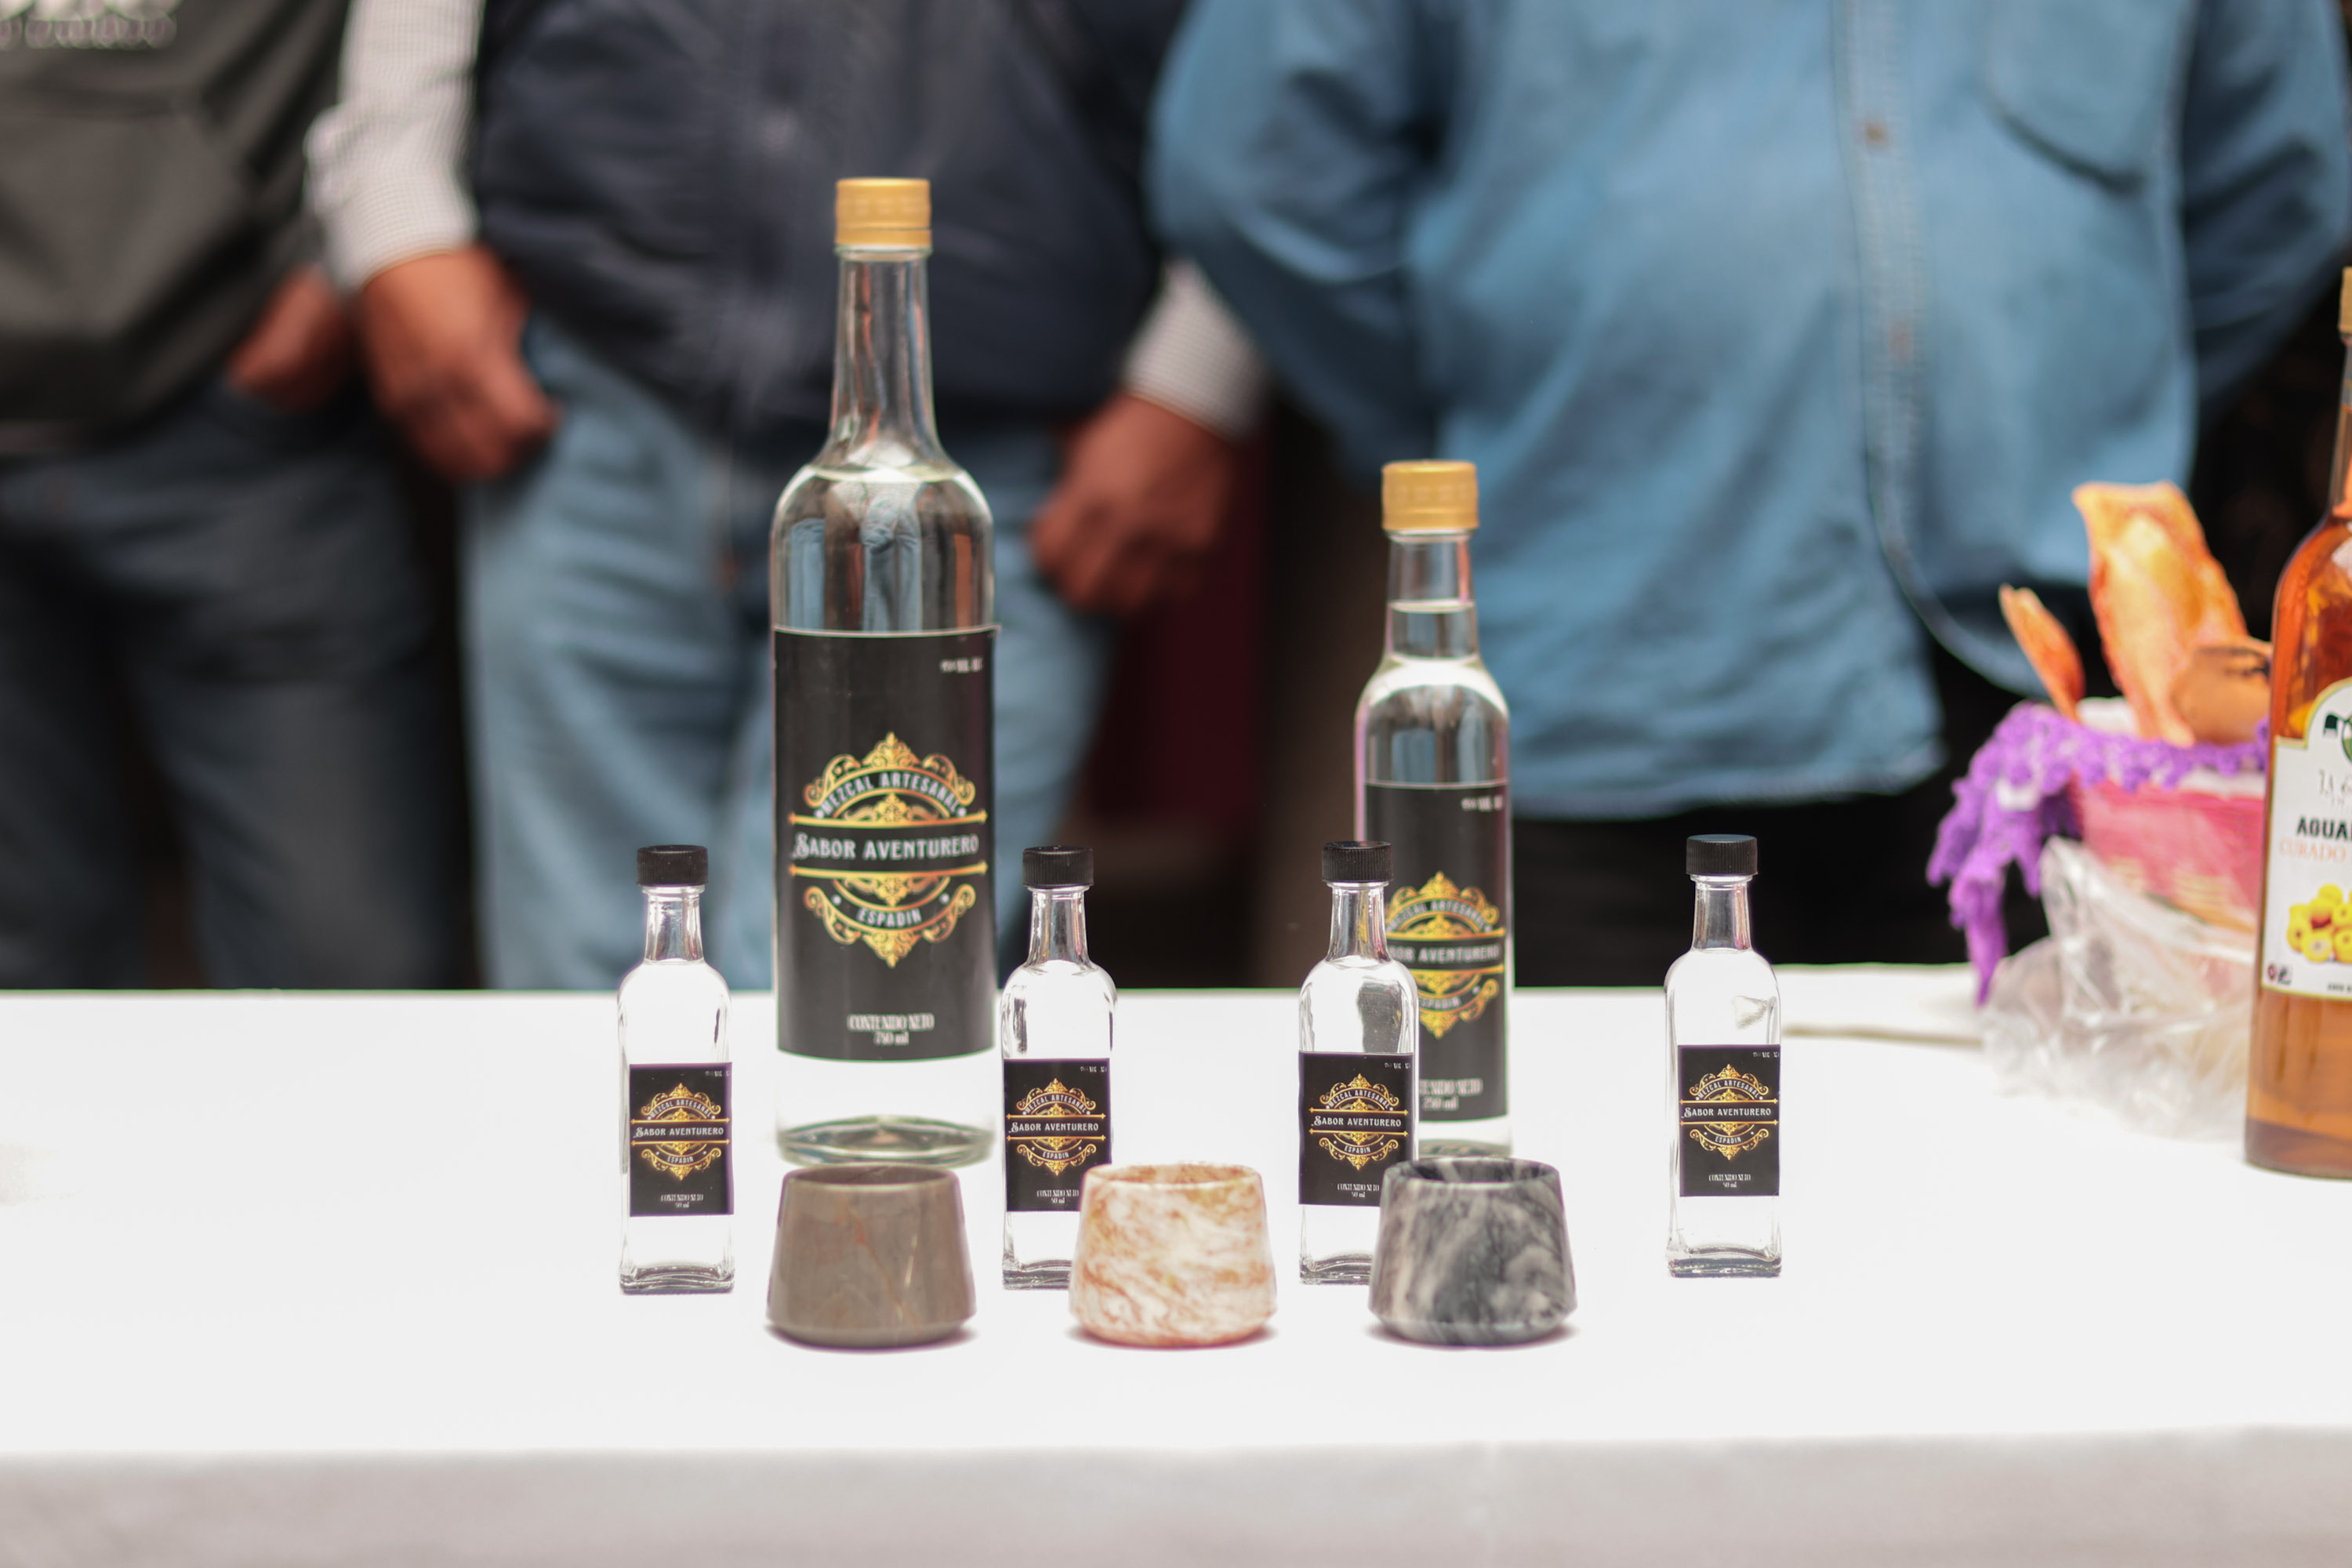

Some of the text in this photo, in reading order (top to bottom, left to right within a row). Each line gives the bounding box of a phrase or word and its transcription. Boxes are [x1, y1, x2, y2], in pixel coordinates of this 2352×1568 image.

[822, 772, 960, 815] MEZCAL ARTESANAL
[2296, 815, 2352, 840] AGUA
[792, 832, 979, 859] SABOR AVENTURERO
[1390, 901, 1486, 929] MEZCAL ARTESANAL
[1388, 945, 1500, 964] BOR AVENTURERO
[848, 1014, 935, 1030] CONTENIDO NETO
[1698, 1080, 1759, 1098] MEZCAL ARTESANAL
[650, 1099, 712, 1118] MEZCAL ARTESANAL
[1025, 1094, 1087, 1113] MEZCAL ARTESANAL
[1328, 1090, 1390, 1109] MEZCAL ARTESANAL
[1311, 1116, 1401, 1127] SABOR AVENTURERO
[1682, 1108, 1714, 1118] SABOR
[633, 1127, 666, 1138] SABOR
[1008, 1122, 1099, 1133] SABOR AVENTURERO
